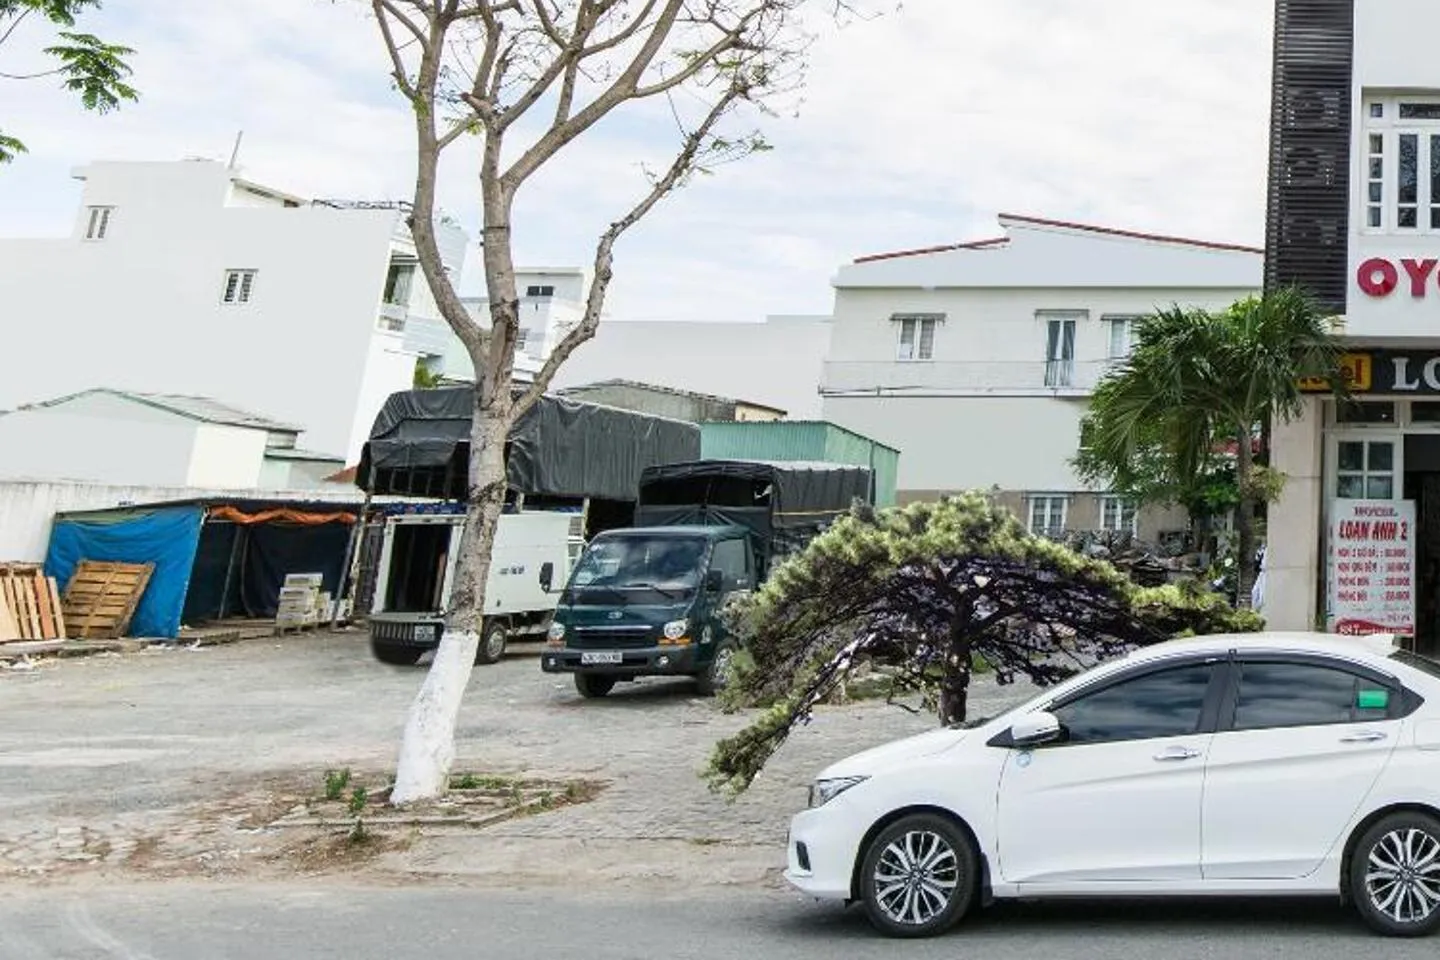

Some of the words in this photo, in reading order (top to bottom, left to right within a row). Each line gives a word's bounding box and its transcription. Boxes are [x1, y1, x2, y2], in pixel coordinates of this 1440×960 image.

[1339, 521, 1370, 540] LOAN
[1371, 521, 1398, 540] ANH
[1400, 521, 1408, 541] 2
